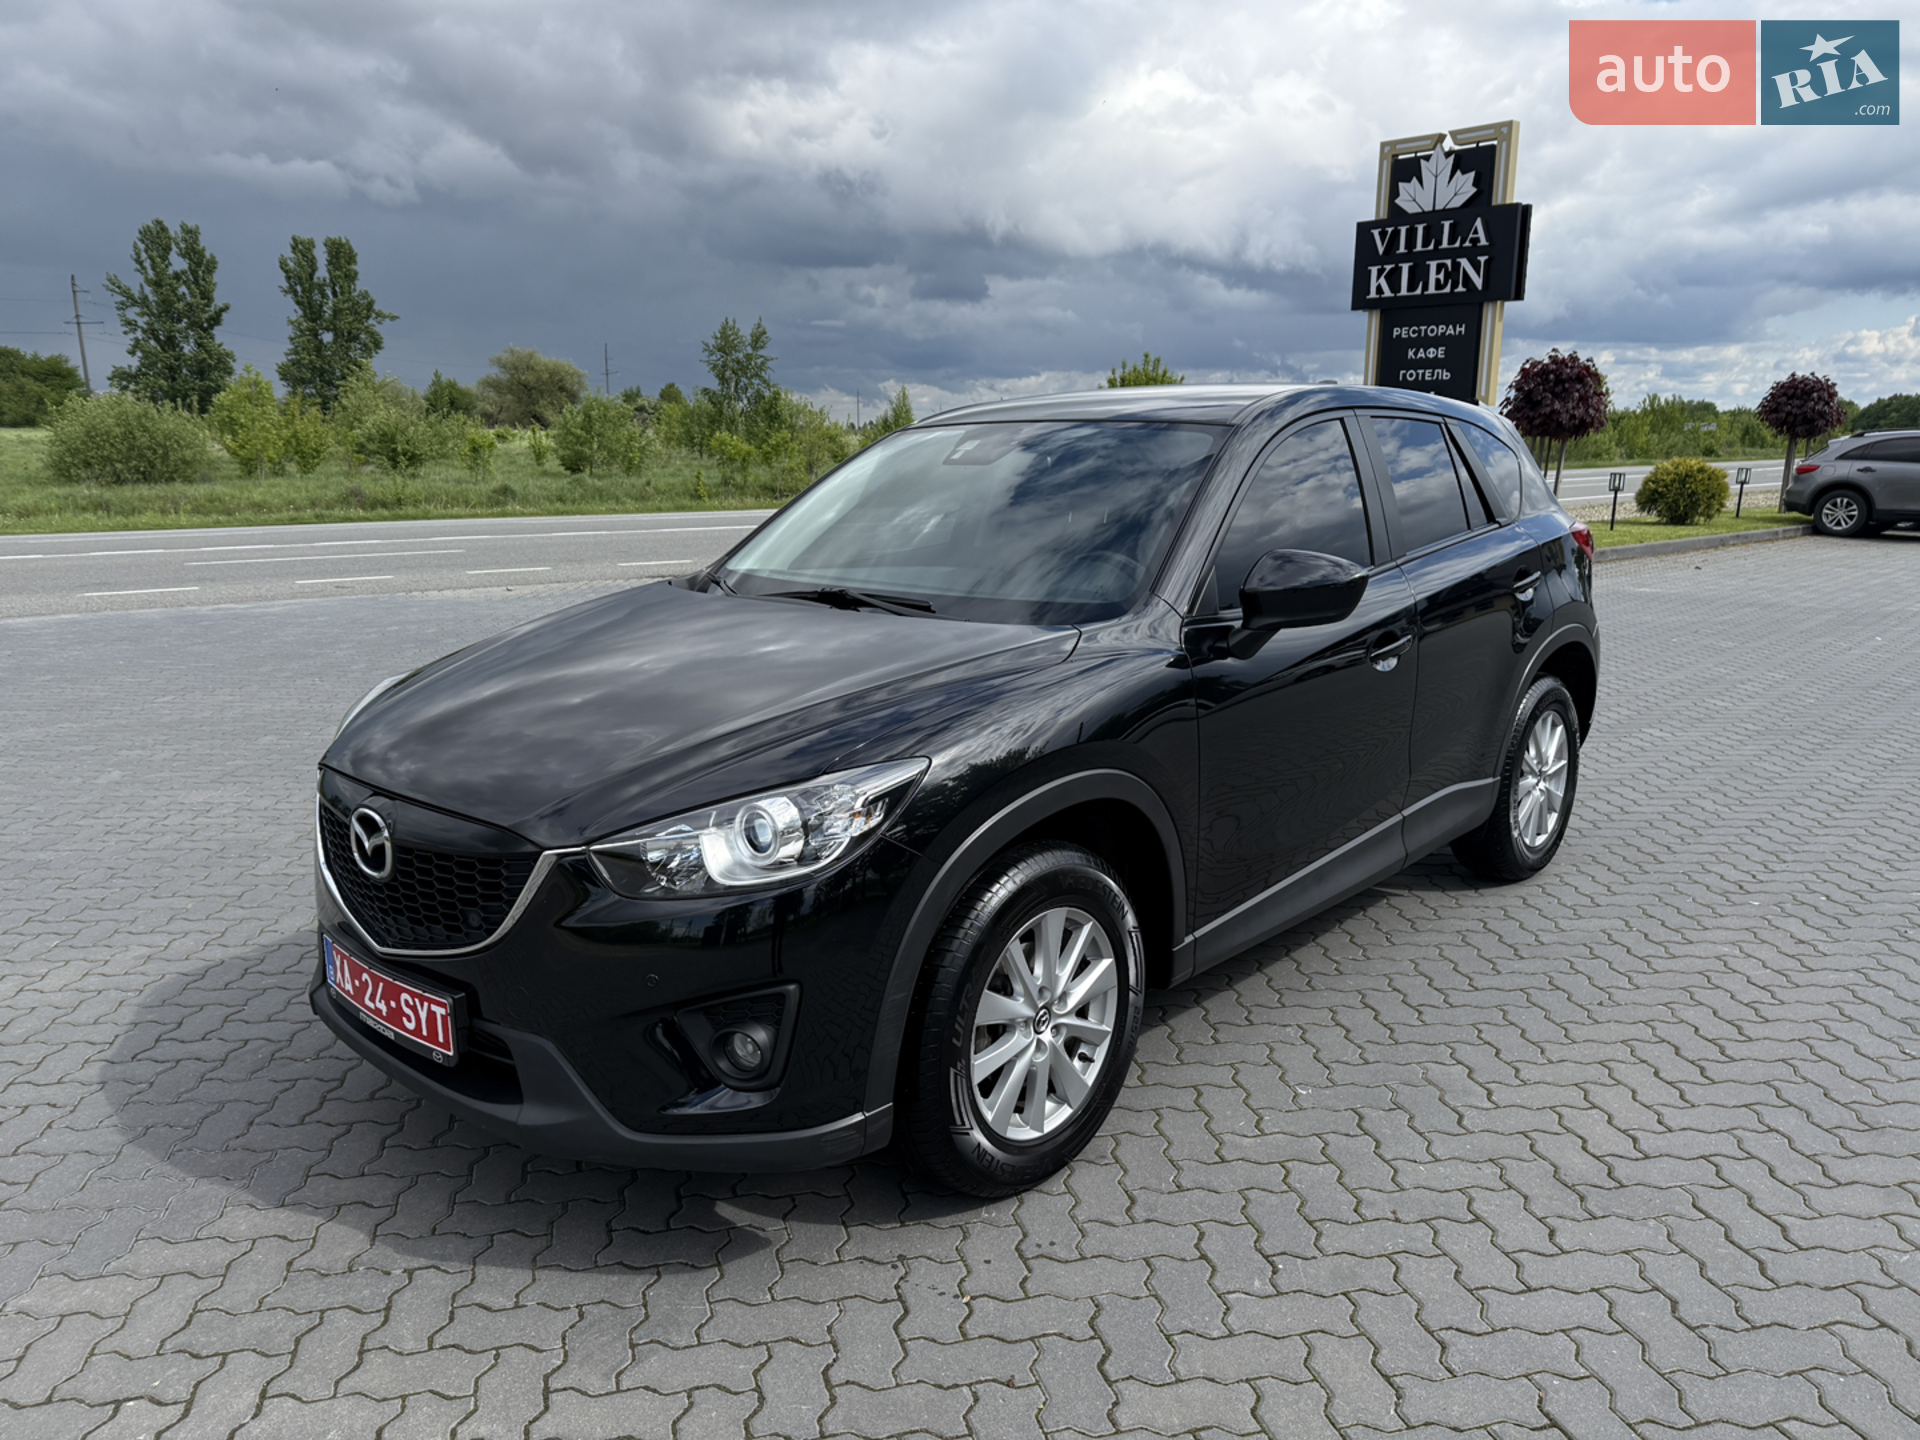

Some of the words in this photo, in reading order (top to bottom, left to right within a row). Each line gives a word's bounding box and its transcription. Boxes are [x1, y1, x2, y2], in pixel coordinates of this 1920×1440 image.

[1370, 216, 1490, 256] VILLA
[1365, 255, 1489, 299] KLEN
[1392, 323, 1466, 339] РЕСТОРАН
[1407, 346, 1446, 360] КАФЕ
[1399, 368, 1452, 382] ГОТЕЛЬ
